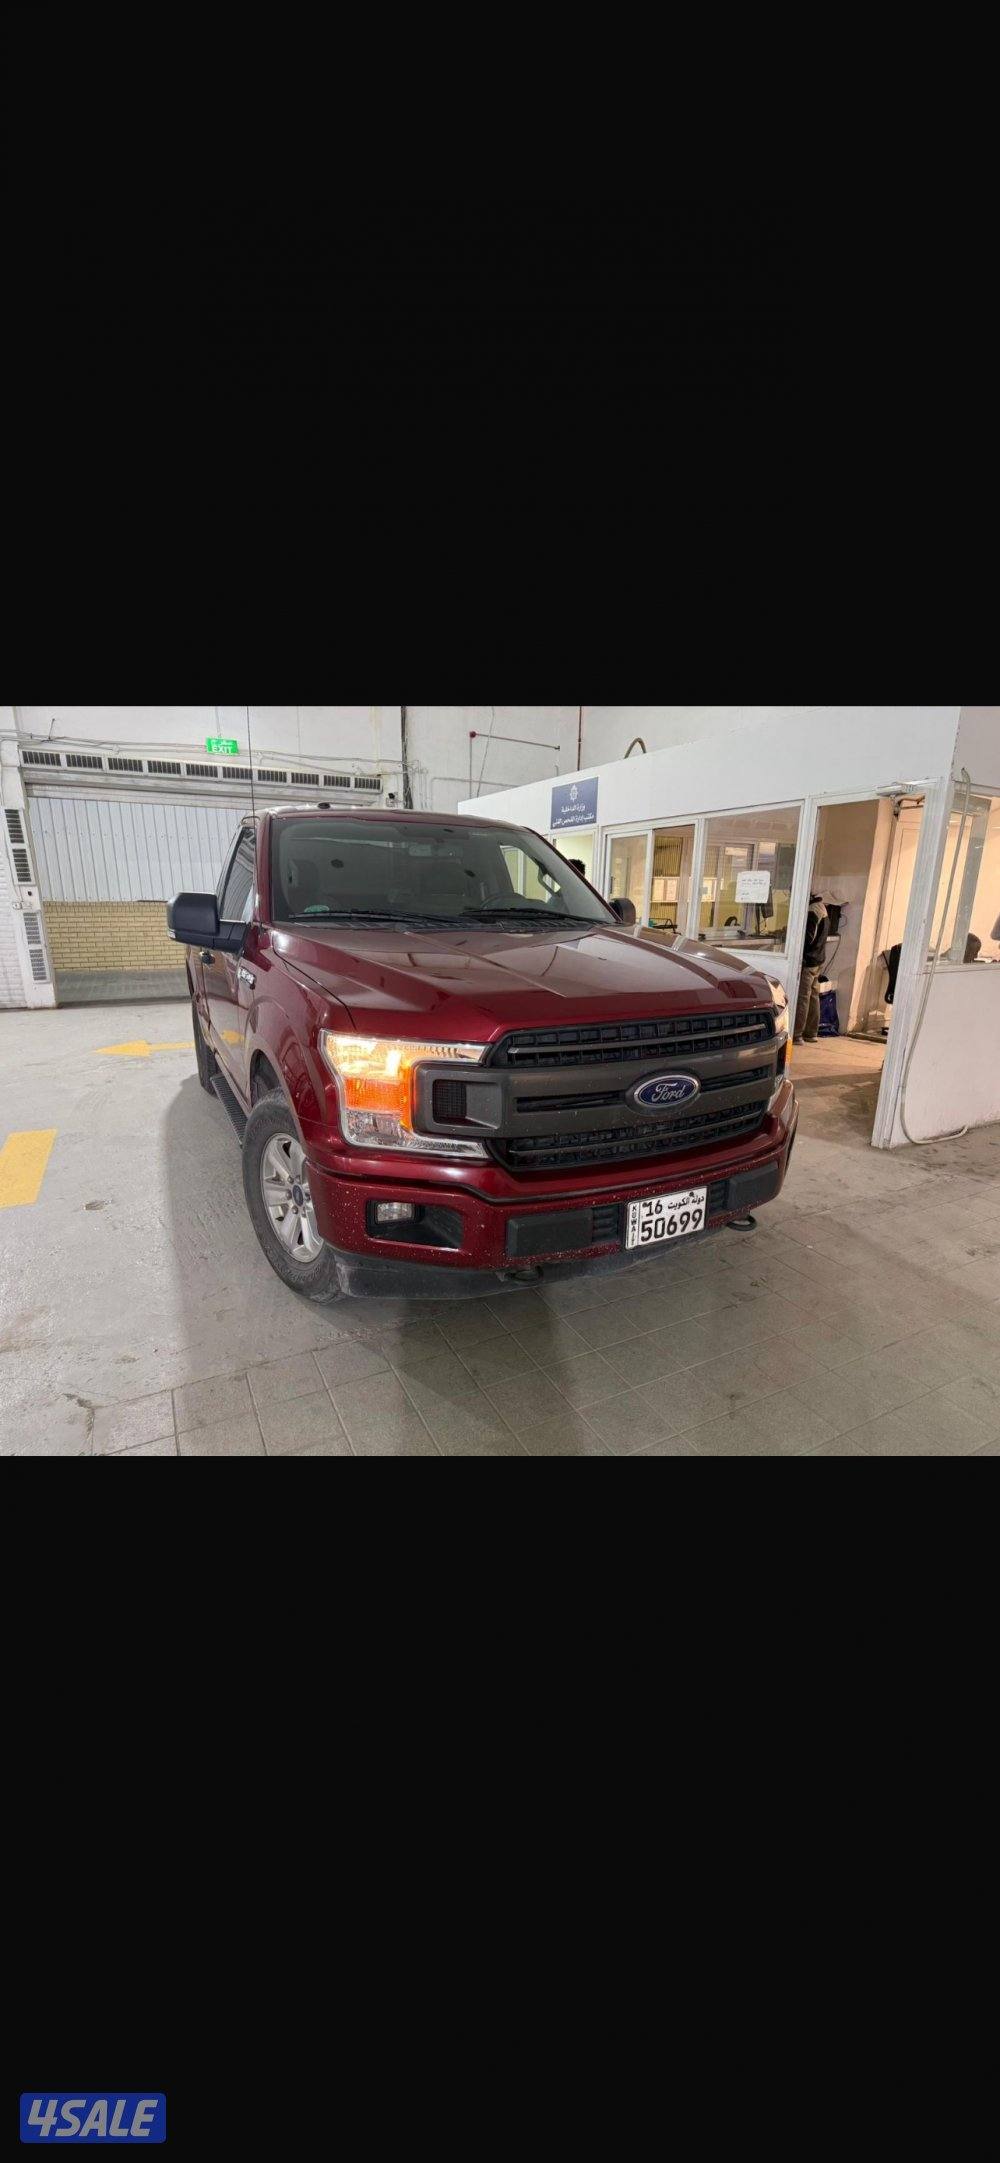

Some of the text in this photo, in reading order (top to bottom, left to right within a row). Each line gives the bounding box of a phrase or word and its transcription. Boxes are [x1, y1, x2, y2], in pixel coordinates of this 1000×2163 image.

[211, 745, 232, 754] EXIT
[651, 1082, 686, 1102] Ford
[645, 1200, 663, 1217] 16
[667, 1196, 690, 1210] الكويت
[641, 1208, 703, 1242] 50699
